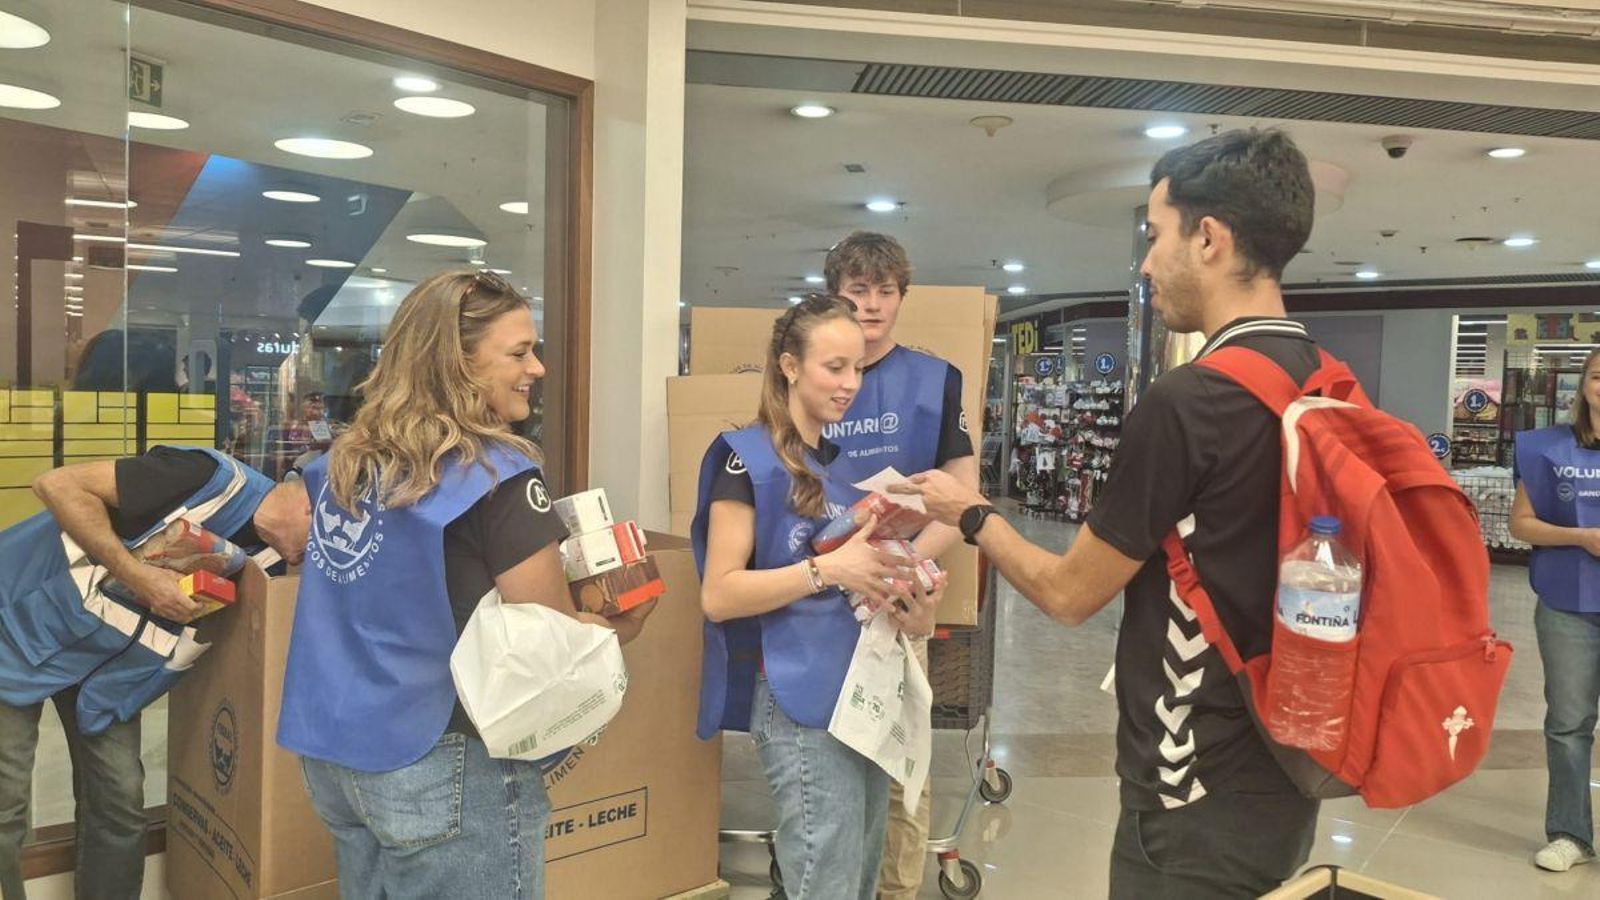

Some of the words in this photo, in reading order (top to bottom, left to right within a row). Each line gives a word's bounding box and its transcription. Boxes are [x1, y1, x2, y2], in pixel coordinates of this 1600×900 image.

[822, 412, 899, 439] UNTARI@
[307, 534, 325, 569] COS
[1296, 613, 1349, 627] FONTIÑA
[588, 803, 637, 828] LECHE
